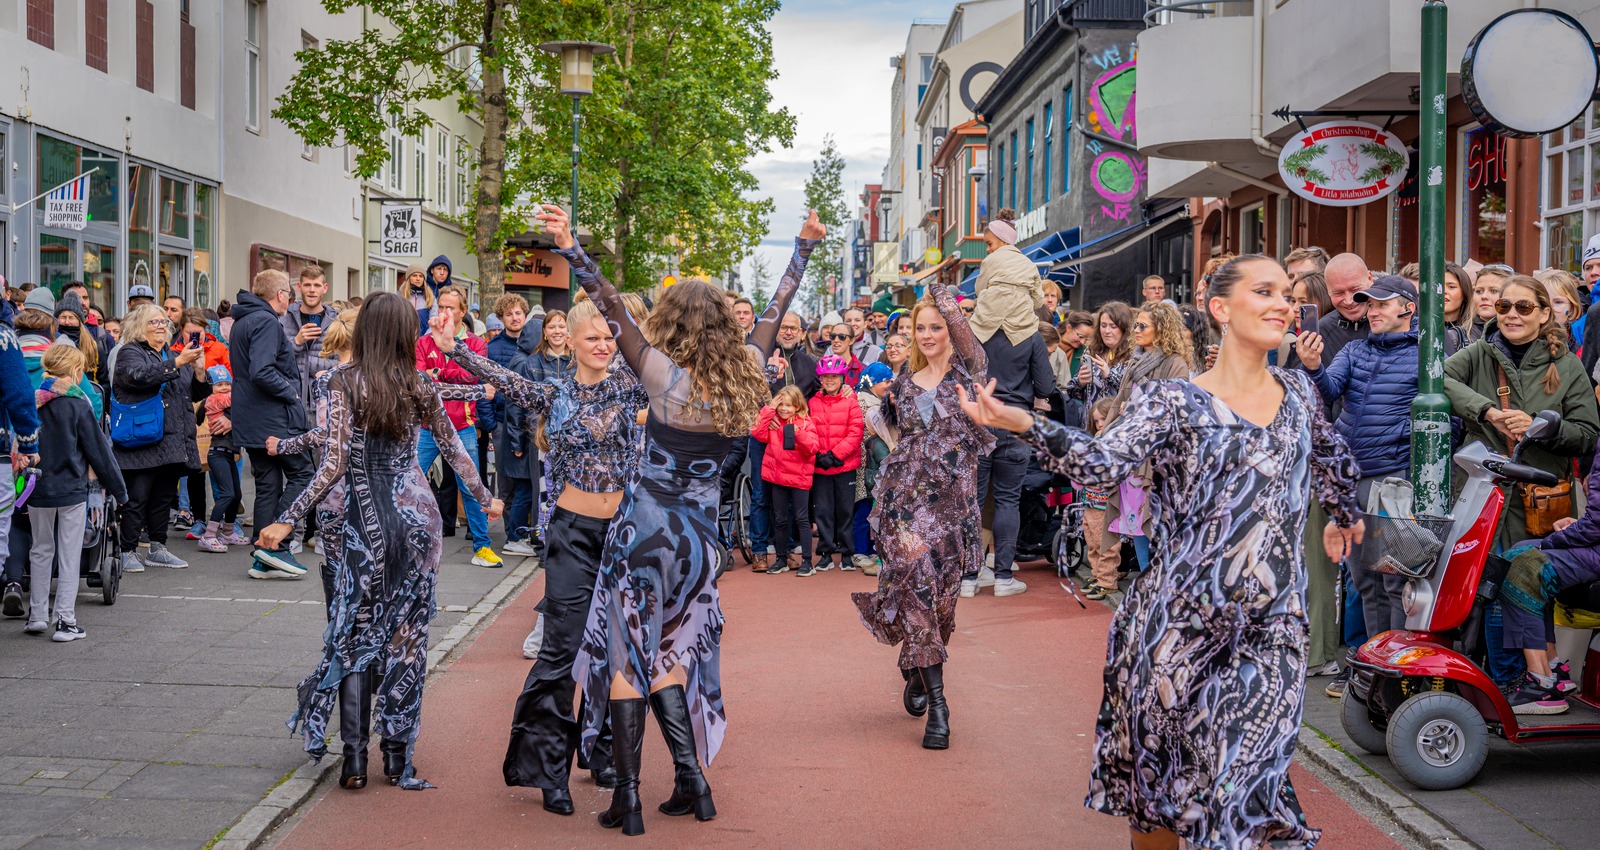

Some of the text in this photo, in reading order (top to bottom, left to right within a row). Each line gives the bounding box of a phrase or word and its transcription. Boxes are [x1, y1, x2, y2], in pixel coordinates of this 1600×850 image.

[1320, 127, 1370, 138] Christmas shop
[1320, 189, 1338, 199] Litla
[50, 202, 83, 213] TAX FREE
[49, 212, 83, 222] SHOPPING
[384, 239, 418, 254] SAGA
